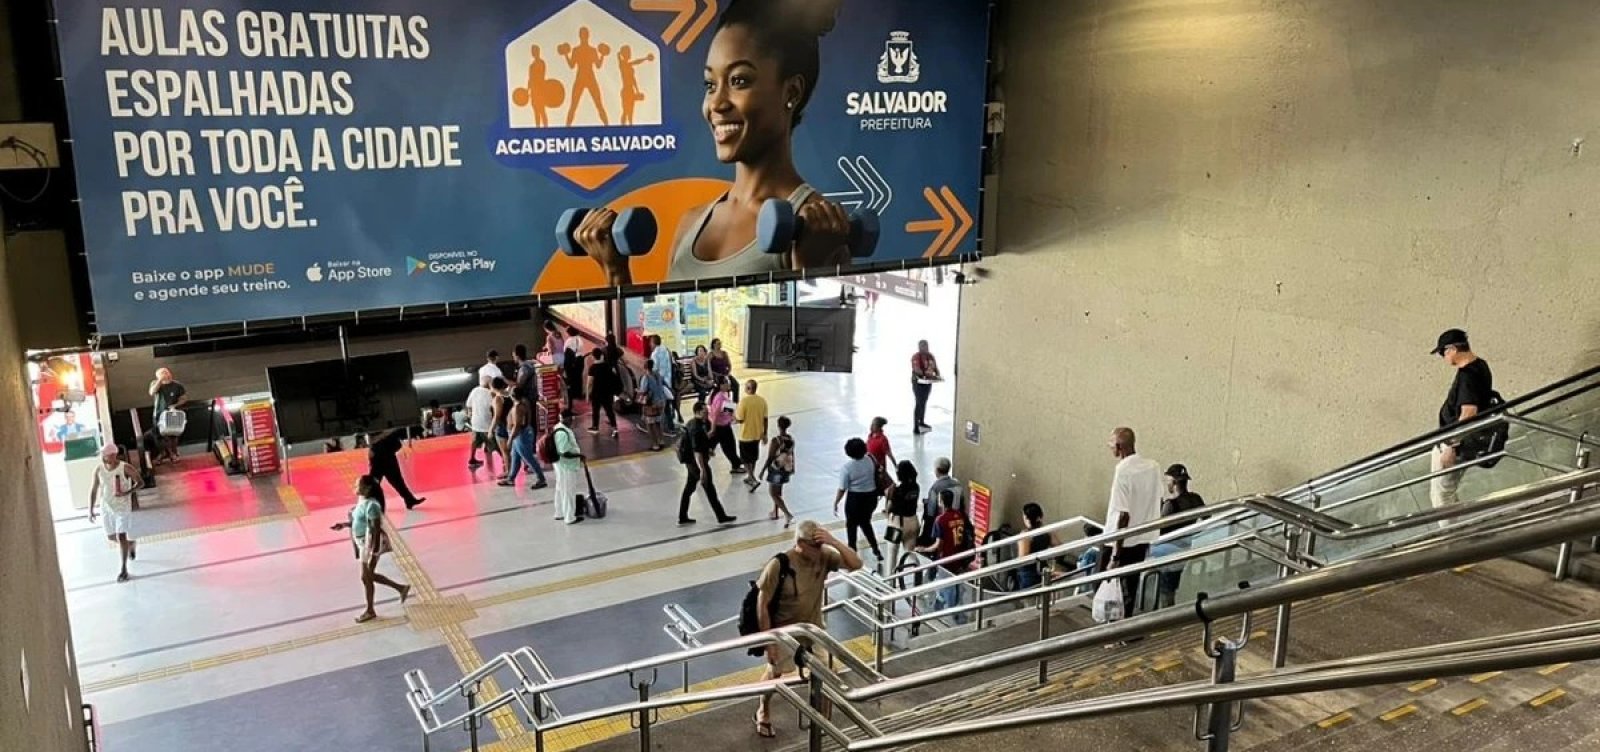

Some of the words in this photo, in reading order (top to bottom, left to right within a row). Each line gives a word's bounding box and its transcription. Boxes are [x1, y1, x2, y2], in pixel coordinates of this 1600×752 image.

[100, 7, 229, 57] AULAS
[237, 12, 430, 60] GRATUITAS
[105, 70, 354, 118] ESPALHADAS
[846, 91, 947, 115] SALVADOR
[860, 117, 932, 131] PREFEITURA
[114, 131, 195, 178] POR
[201, 128, 303, 175] TODA
[311, 127, 335, 172] A
[342, 125, 462, 171] CIDADE
[495, 137, 587, 155] ACADEMIA
[591, 134, 676, 152] SALVADOR
[121, 189, 204, 237] PRA
[208, 176, 317, 232] VOCÊ.
[132, 270, 176, 284] Baixe
[180, 270, 190, 280] o
[194, 268, 225, 282] app
[228, 263, 276, 277] MUDE
[327, 269, 355, 282] App
[357, 266, 392, 278] Store
[429, 260, 471, 274] Google
[472, 258, 496, 271] Play
[134, 290, 144, 300] e
[148, 284, 208, 301] agende
[212, 284, 239, 294] seu
[243, 278, 291, 292] treino.
